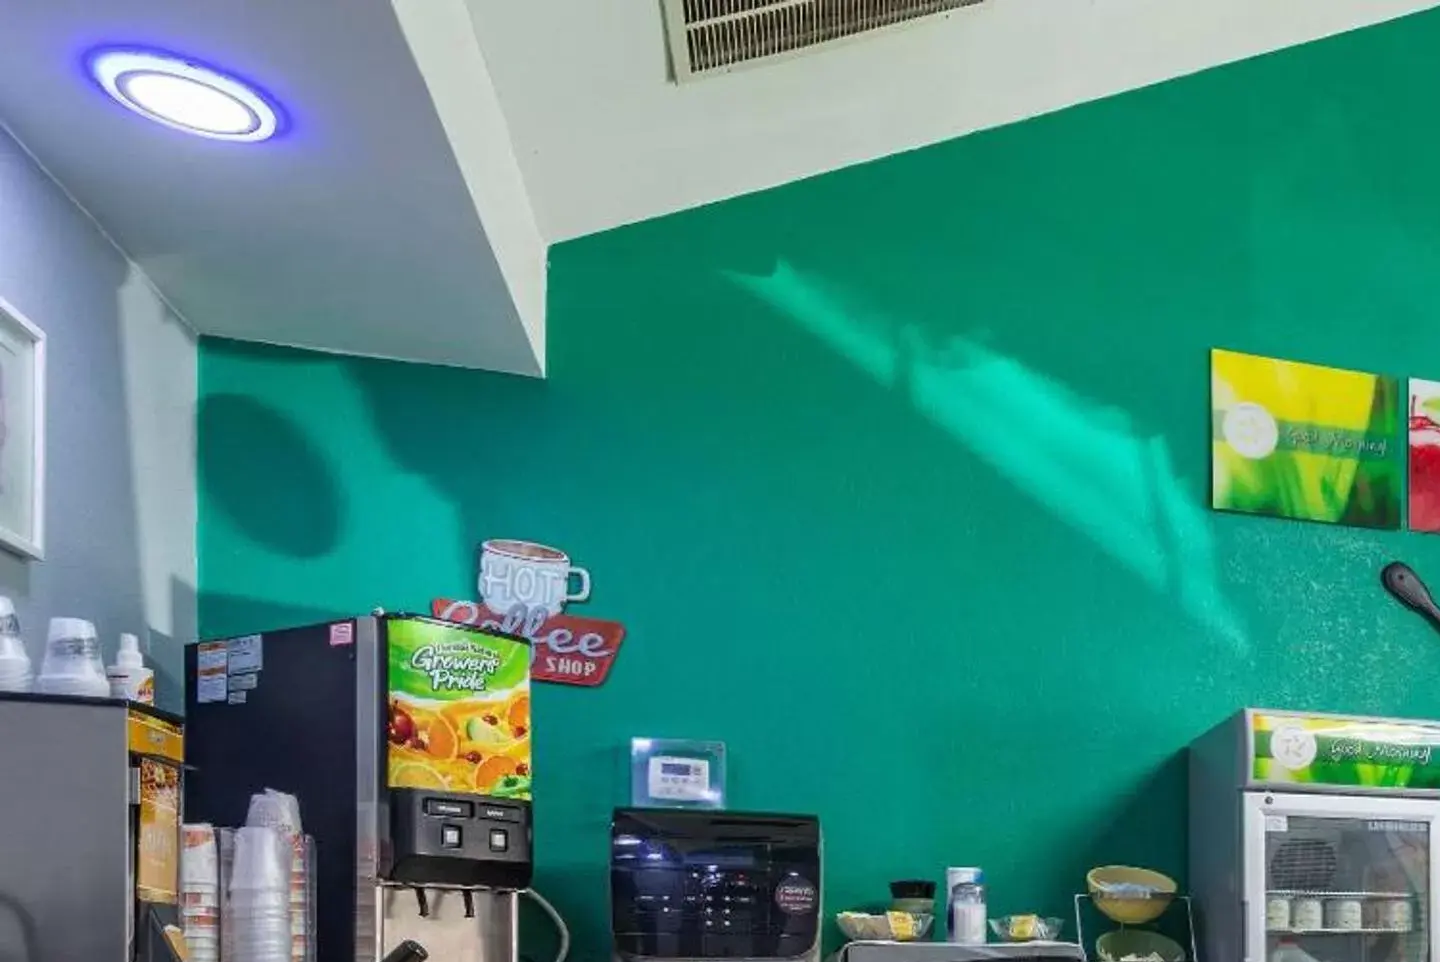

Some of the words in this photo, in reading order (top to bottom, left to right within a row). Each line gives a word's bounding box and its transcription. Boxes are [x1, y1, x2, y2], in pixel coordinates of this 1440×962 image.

[484, 563, 559, 603] HOT
[545, 656, 597, 677] SHOP
[429, 667, 486, 691] Pride
